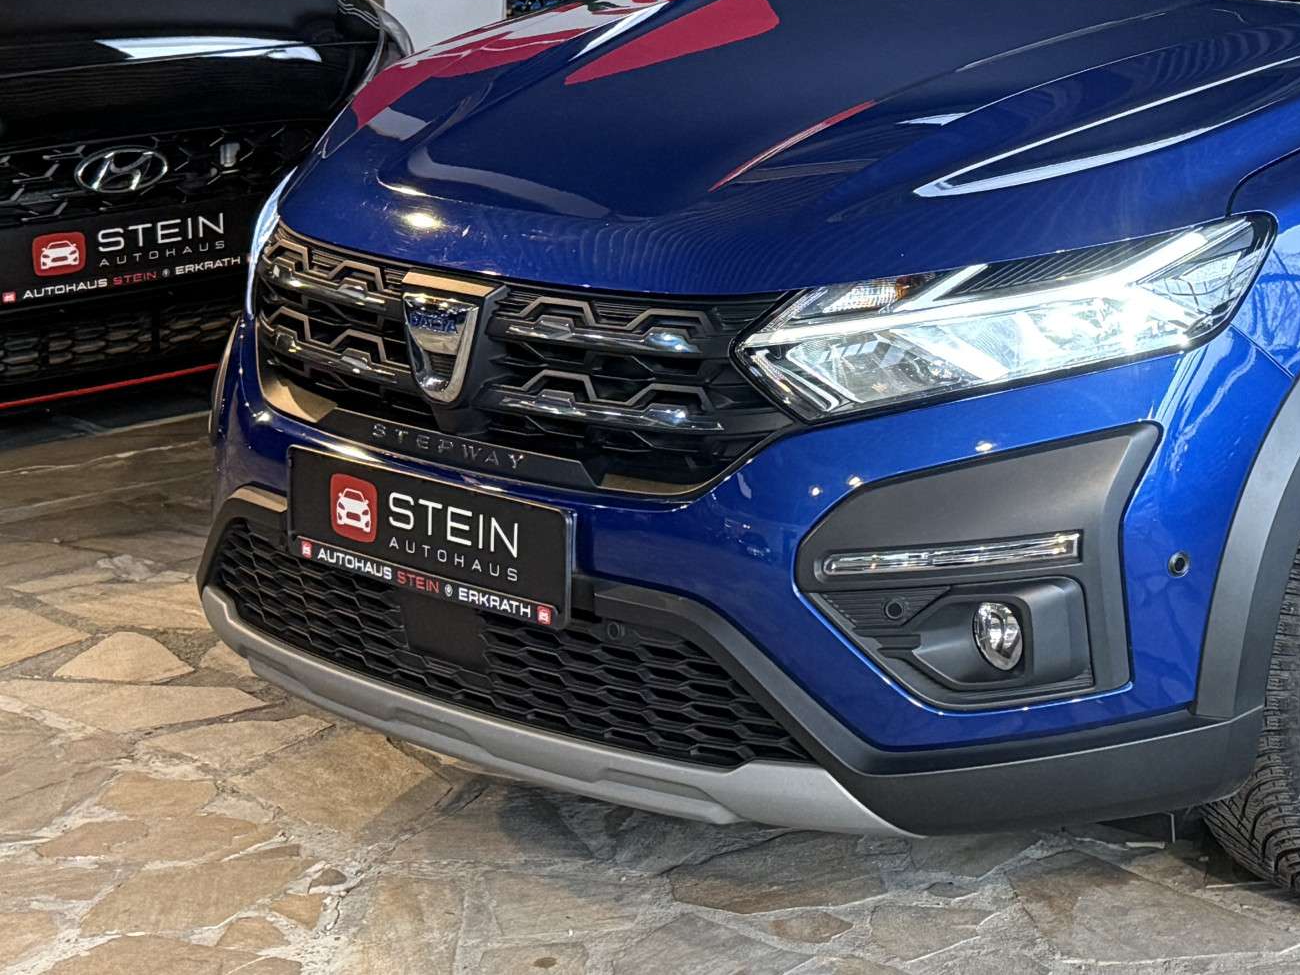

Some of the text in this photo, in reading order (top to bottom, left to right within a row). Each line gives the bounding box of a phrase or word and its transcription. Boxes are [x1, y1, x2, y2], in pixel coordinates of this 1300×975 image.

[98, 212, 225, 252] STEIN
[99, 240, 225, 268] AUTOHAUS
[22, 256, 241, 300] AUTOHAUS STEIN ERKRATH
[372, 423, 524, 469] STEPWAY
[388, 491, 518, 558] STEIN
[389, 536, 518, 582] AUTOHAUS
[317, 547, 531, 618] AUTOHAUS STEIN ERKRATH
